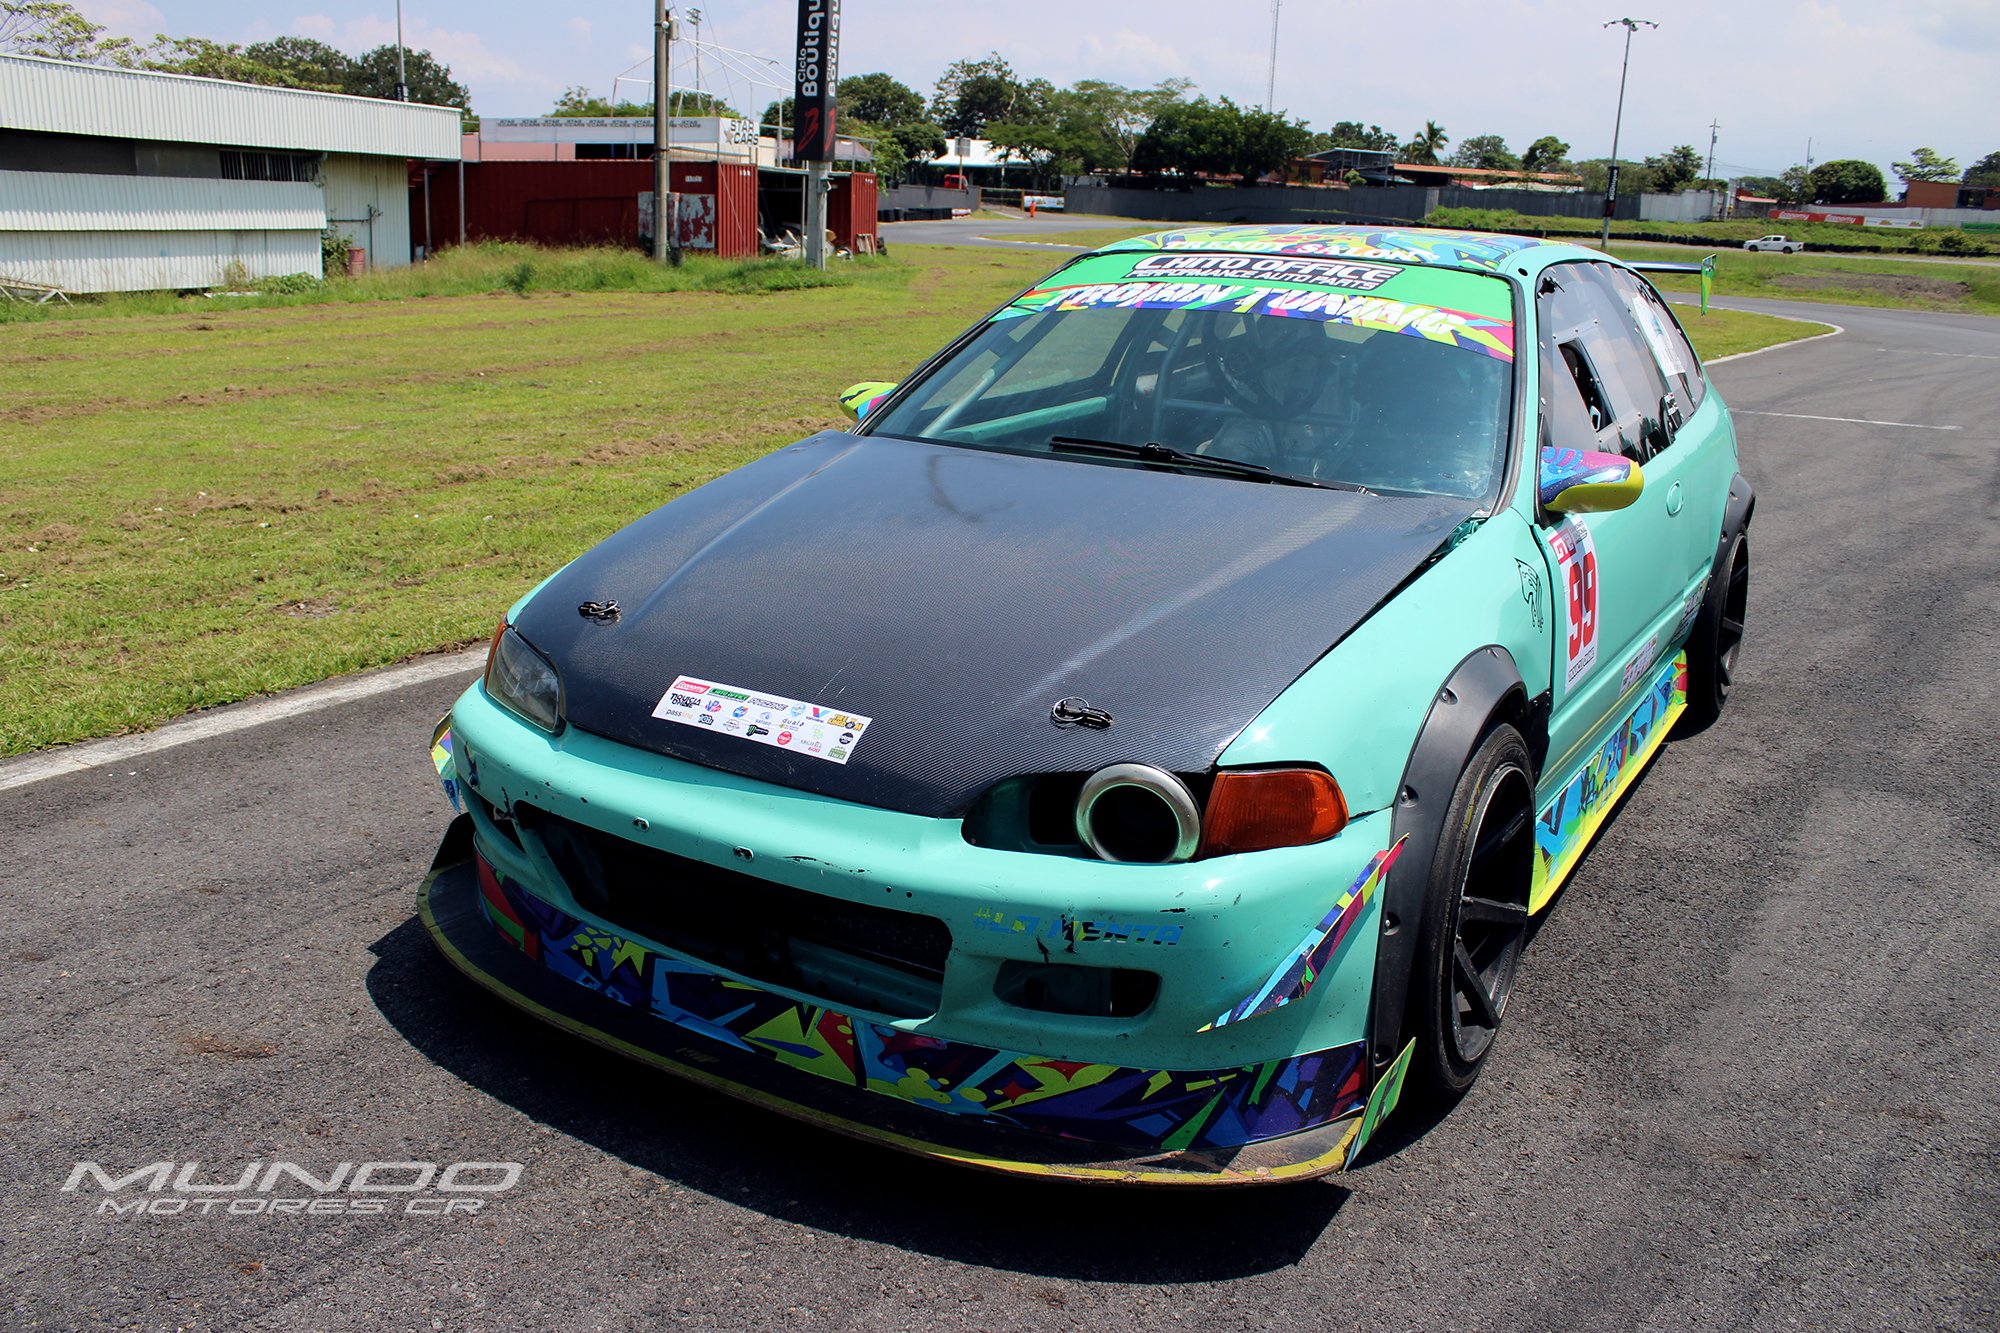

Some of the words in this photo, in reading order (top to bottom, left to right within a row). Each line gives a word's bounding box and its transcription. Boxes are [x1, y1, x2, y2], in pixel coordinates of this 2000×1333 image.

[730, 119, 754, 132] STAR
[733, 132, 759, 146] CARS
[1778, 211, 1810, 221] Economy
[1824, 214, 1856, 224] Economy
[1134, 253, 1245, 271] CHITO
[1251, 259, 1401, 283] OFFICE
[1127, 269, 1258, 280] PERFORMANCE
[1261, 271, 1311, 283] AUTO
[1309, 275, 1380, 291] PARTS
[1569, 551, 1597, 661] 99
